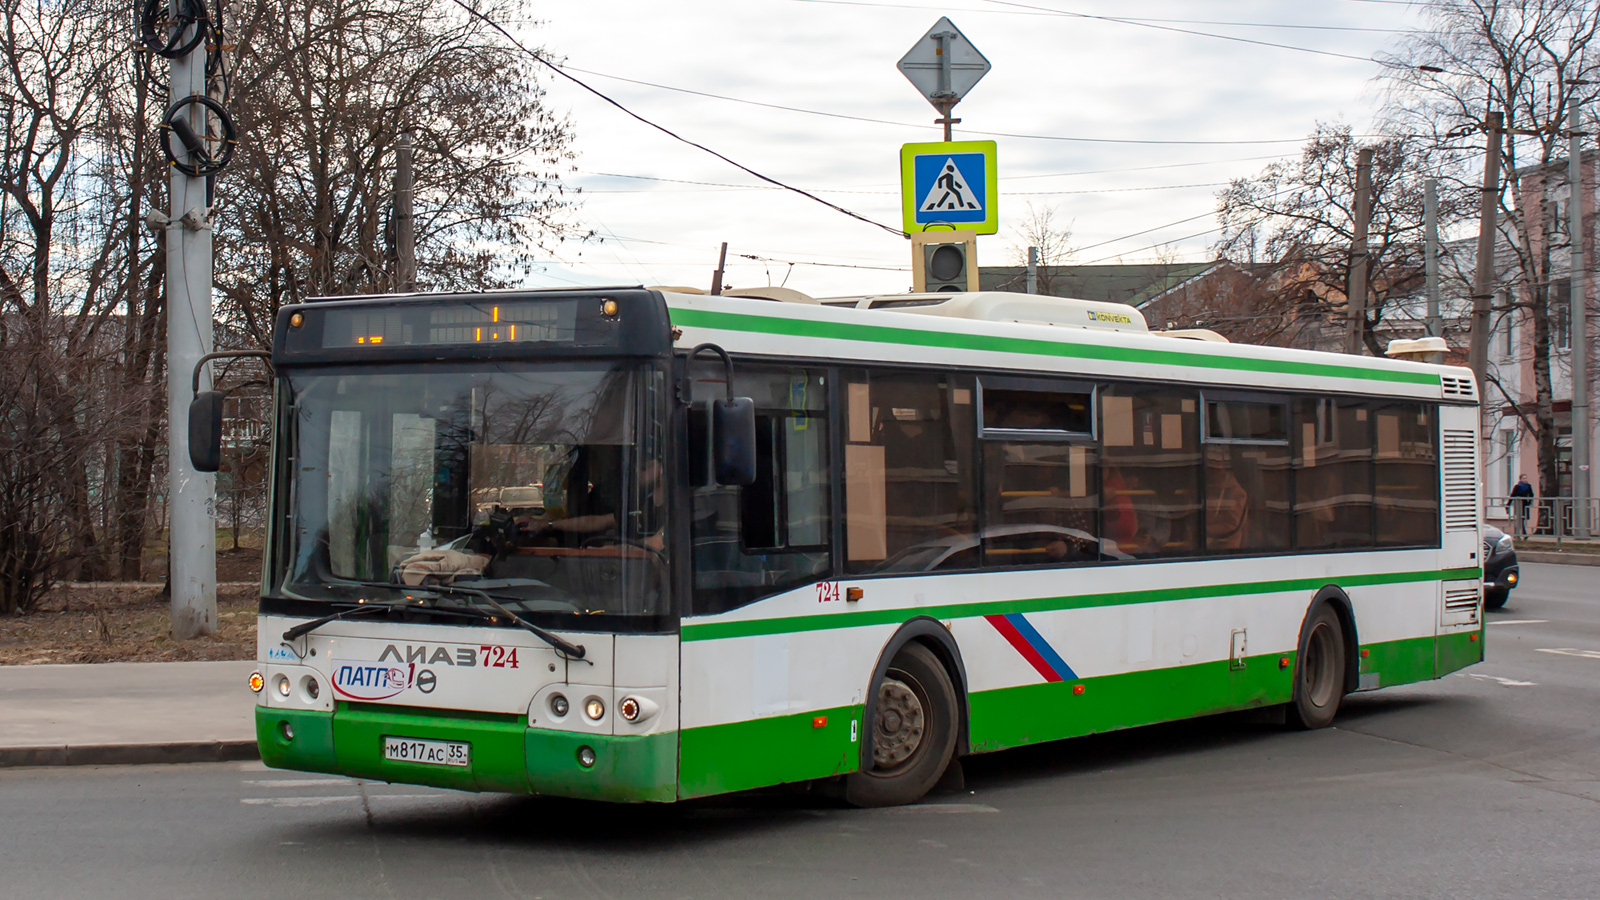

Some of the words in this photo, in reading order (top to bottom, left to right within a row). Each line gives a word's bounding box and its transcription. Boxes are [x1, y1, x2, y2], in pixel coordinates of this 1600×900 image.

[1096, 312, 1132, 324] KONVEKTA
[815, 581, 840, 603] 724
[378, 644, 477, 667] ЛИАЗ
[480, 645, 519, 668] 724
[448, 744, 463, 759] 35
